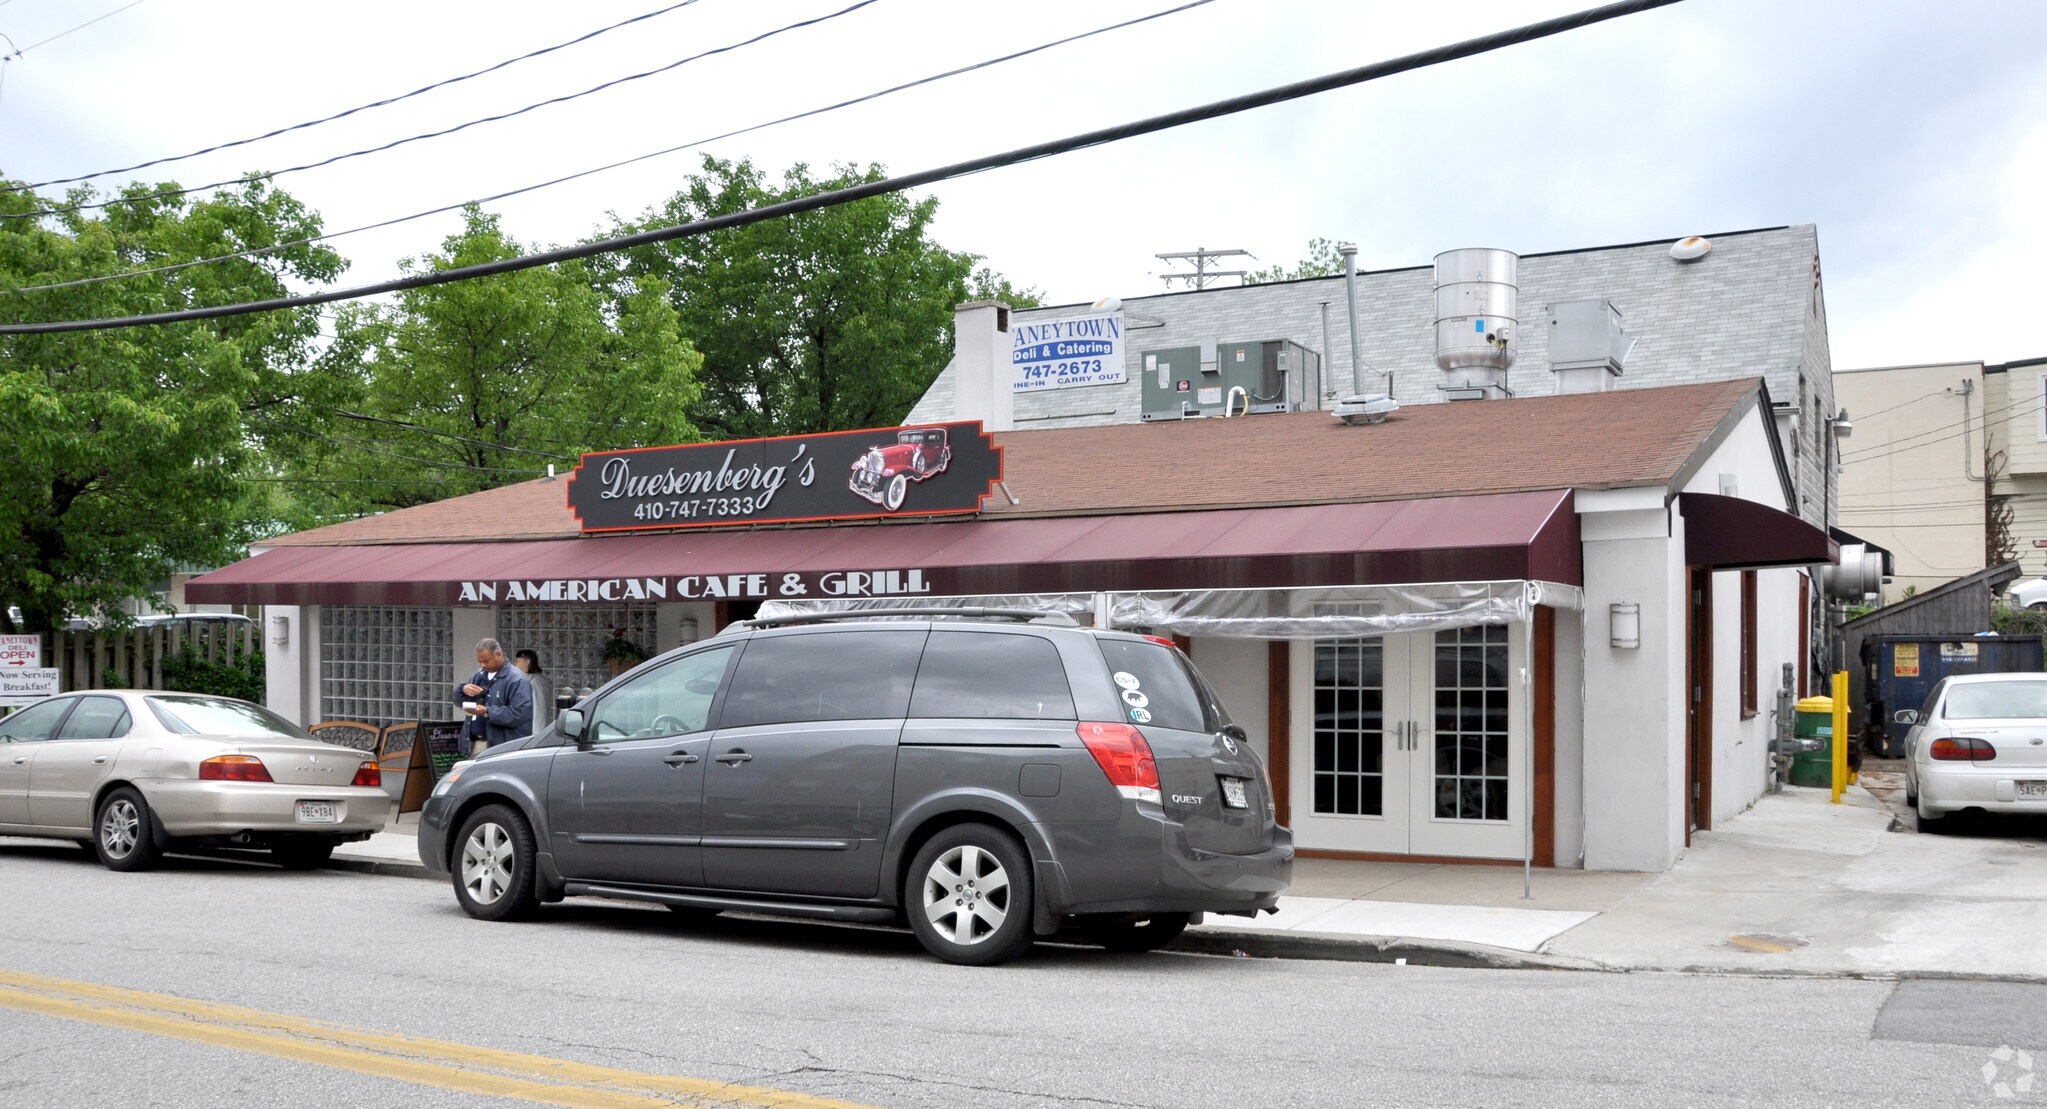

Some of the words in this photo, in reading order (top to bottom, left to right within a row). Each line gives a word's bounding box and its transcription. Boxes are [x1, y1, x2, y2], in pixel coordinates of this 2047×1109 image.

[1012, 317, 1119, 347] ANEYTOWN
[1013, 349, 1036, 361] Deli
[1042, 345, 1051, 357] &
[1057, 341, 1111, 356] Catering
[1023, 359, 1102, 379] 747-2673
[1013, 380, 1045, 388] INE-IN
[1057, 375, 1092, 384] CARRY
[1098, 372, 1121, 381] OUT
[601, 443, 815, 509] Duesenberg's
[633, 496, 754, 520] 410-747-7333
[458, 581, 497, 601] AN
[505, 577, 667, 602] AMERICAN
[677, 574, 768, 598] CAFE
[779, 573, 807, 596] &
[819, 569, 930, 597] GRILL
[0, 651, 35, 659] OPEN
[21, 670, 57, 680] Serving
[4, 682, 52, 691] Breakfast!
[1132, 710, 1150, 721] IRL
[1171, 794, 1203, 805] QUEST
